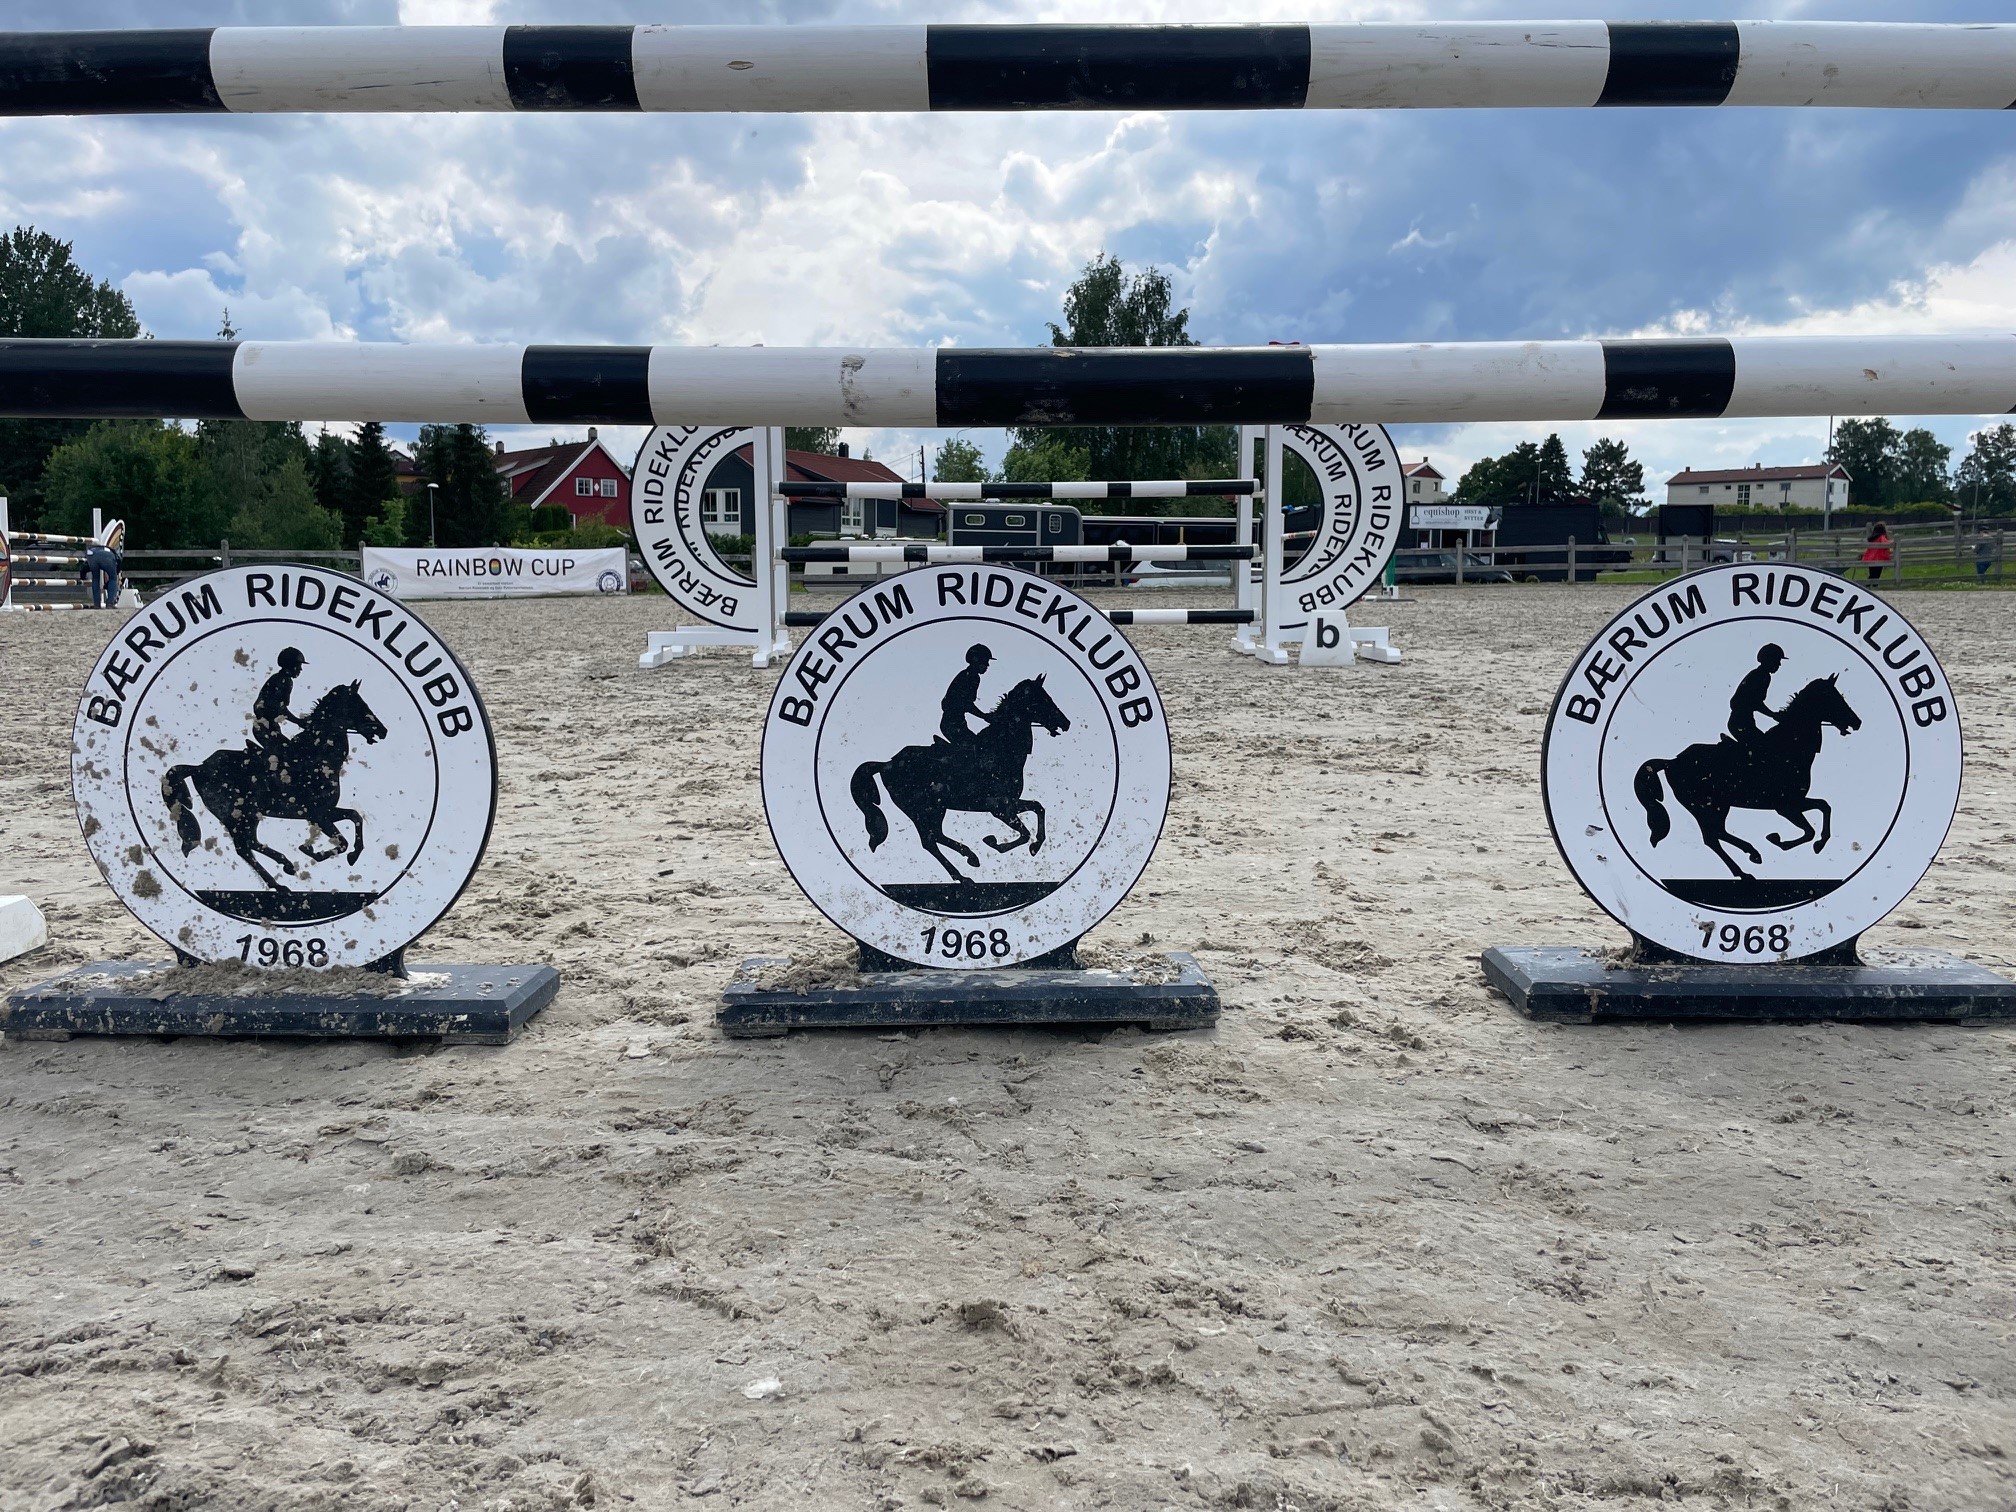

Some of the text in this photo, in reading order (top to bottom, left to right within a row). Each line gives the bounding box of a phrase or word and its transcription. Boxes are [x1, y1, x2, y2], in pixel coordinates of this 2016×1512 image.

[1423, 507, 1460, 518] equishop
[416, 558, 523, 576] RAINBOW
[531, 558, 575, 576] CUP
[1299, 485, 1392, 612] RIDEKLUBB
[652, 538, 738, 617] BÆRUM
[87, 573, 474, 738] BÆRUM RIDEKLUBB
[779, 573, 1154, 728] BÆRUM RIDEKLUBB
[1566, 573, 1947, 728] BÆRUM RIDEKLUBB
[236, 934, 328, 968] 1968
[920, 926, 1011, 960] 1968
[1698, 921, 1790, 954] 1968
